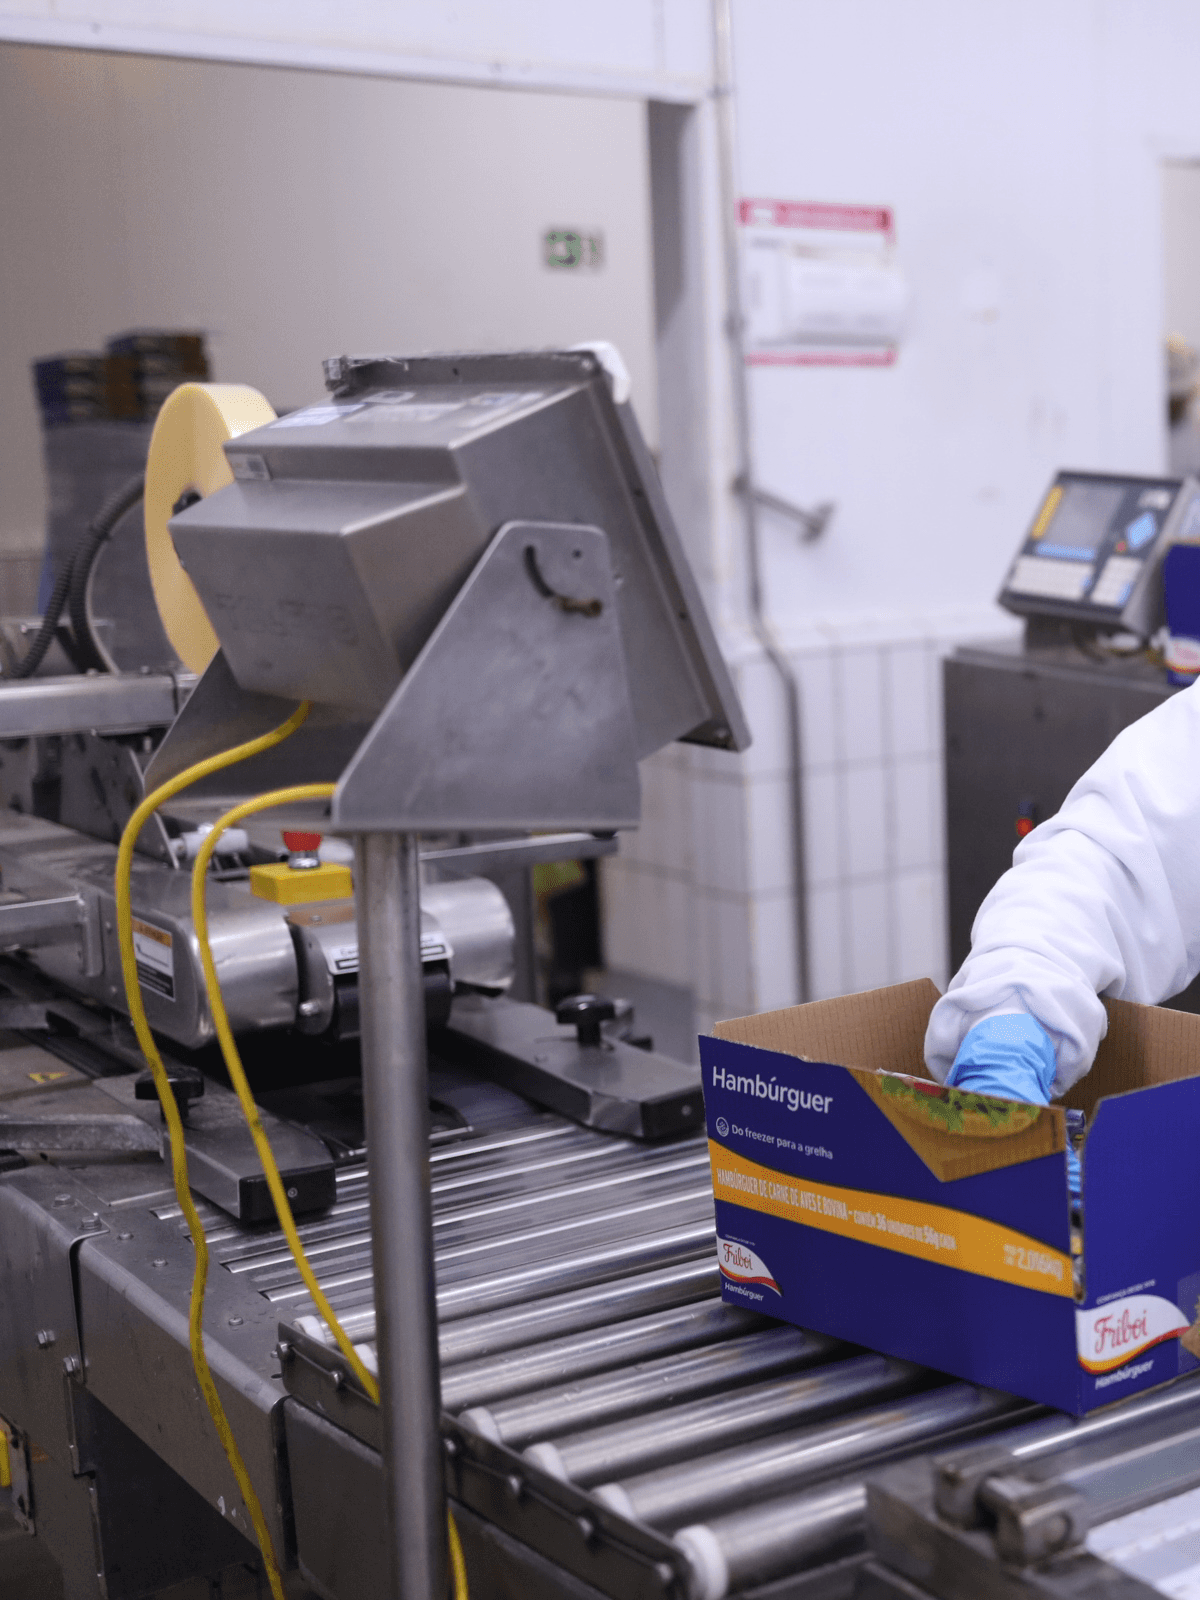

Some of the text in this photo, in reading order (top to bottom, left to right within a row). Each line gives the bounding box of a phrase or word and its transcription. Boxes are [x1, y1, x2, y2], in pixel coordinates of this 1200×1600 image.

[712, 1066, 833, 1114] Hambúrguer
[731, 1124, 834, 1160] Do freezer para a grelha
[723, 1243, 753, 1270] Friboi
[724, 1282, 764, 1302] Hambúrguer
[1094, 1308, 1148, 1354] Friboi
